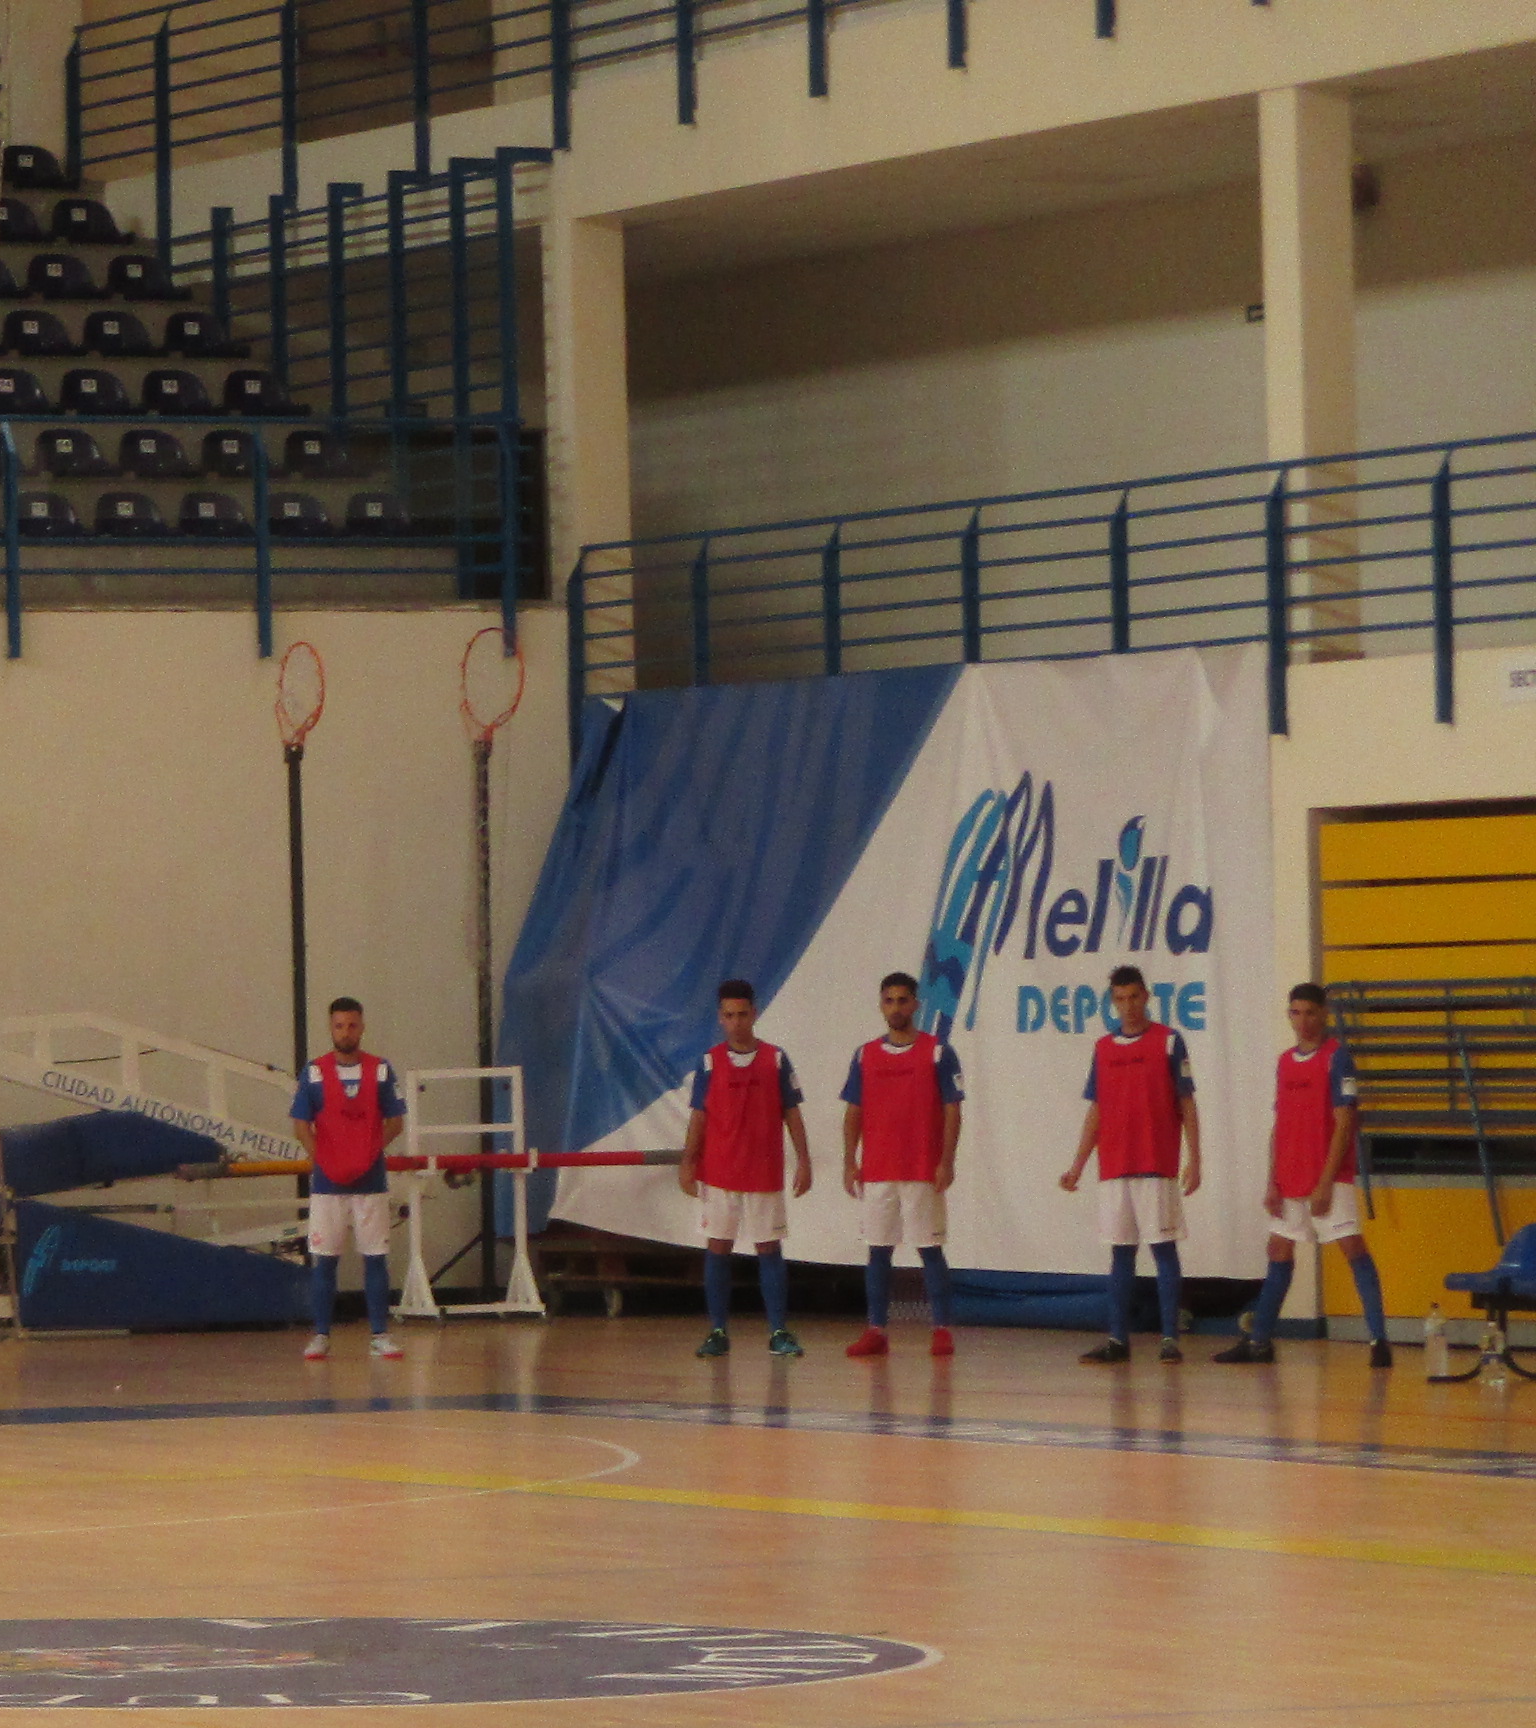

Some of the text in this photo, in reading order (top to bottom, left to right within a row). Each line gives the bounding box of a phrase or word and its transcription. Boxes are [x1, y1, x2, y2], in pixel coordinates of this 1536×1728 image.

[948, 770, 1214, 960] Melilla
[1016, 981, 1207, 1034] DEPOTE
[42, 1070, 116, 1105] CIUDAD
